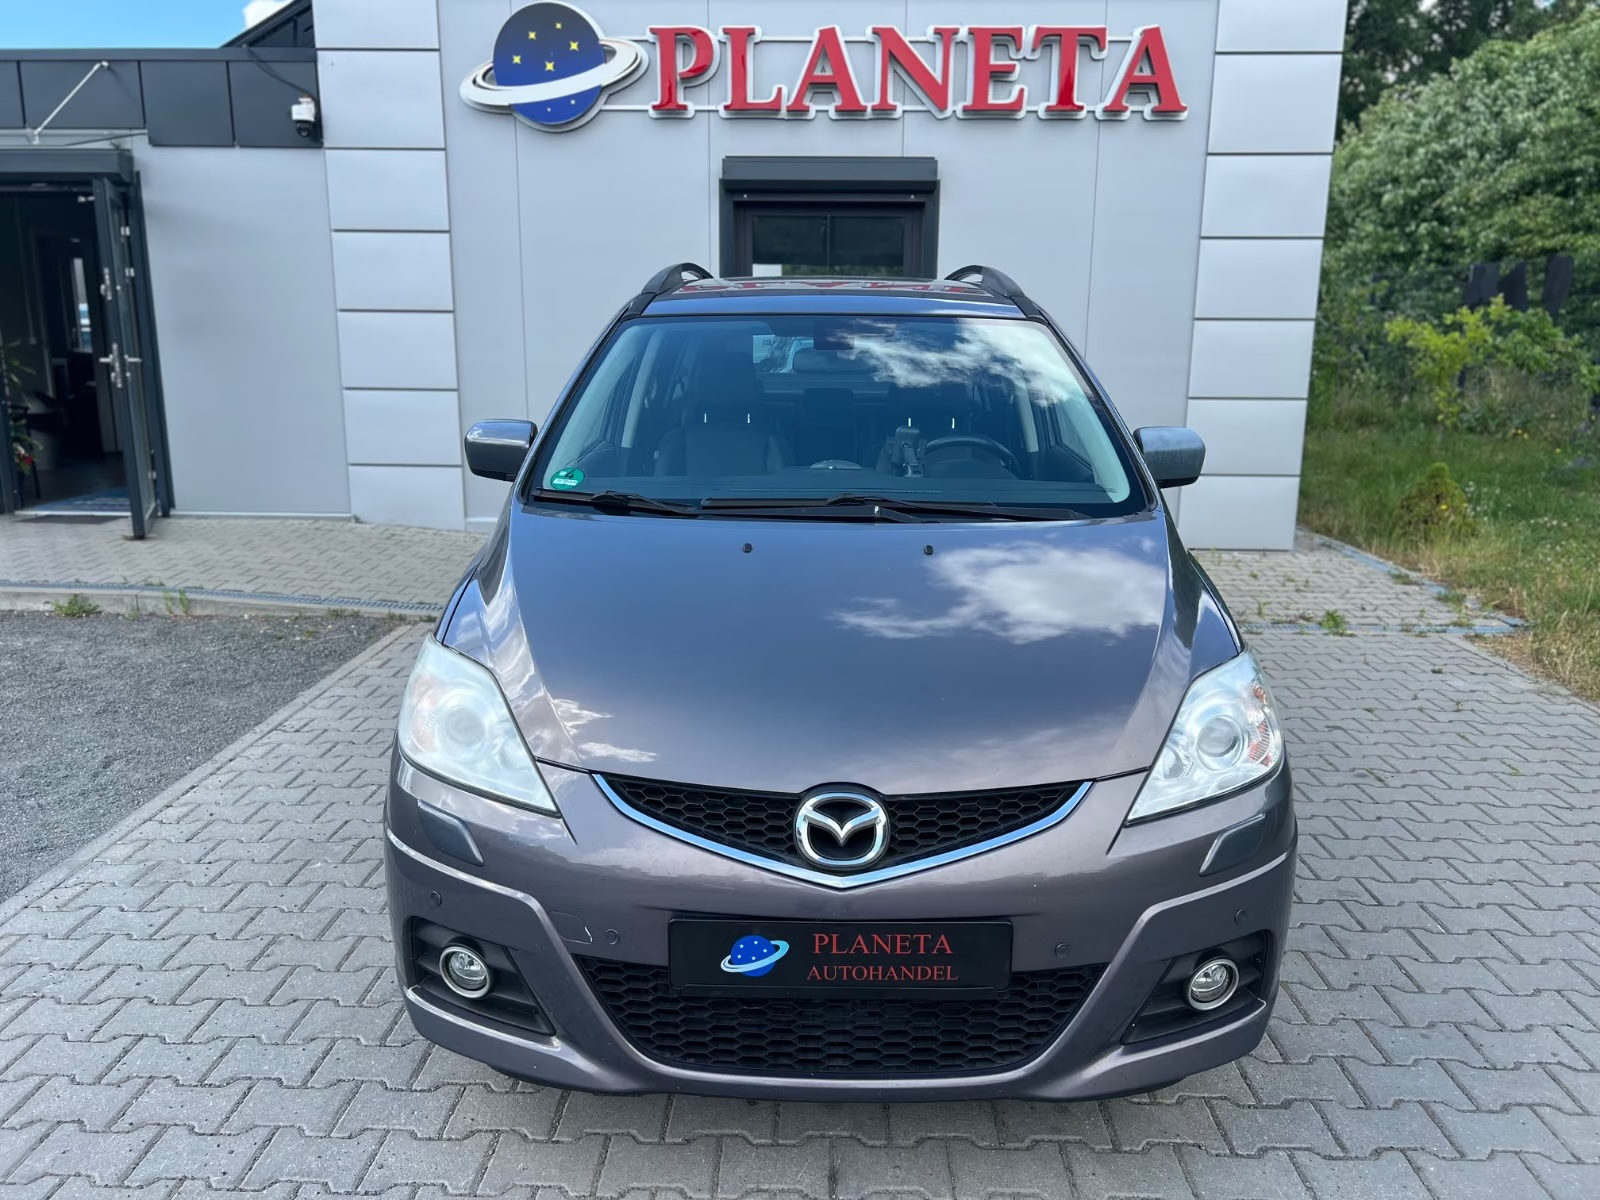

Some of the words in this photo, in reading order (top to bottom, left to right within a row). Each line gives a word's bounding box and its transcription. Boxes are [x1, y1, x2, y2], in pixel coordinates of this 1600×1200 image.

[649, 25, 1188, 115] PLANETA
[564, 468, 576, 480] 4
[813, 933, 953, 955] PLANETA
[807, 965, 959, 981] AUTOHANDEL
